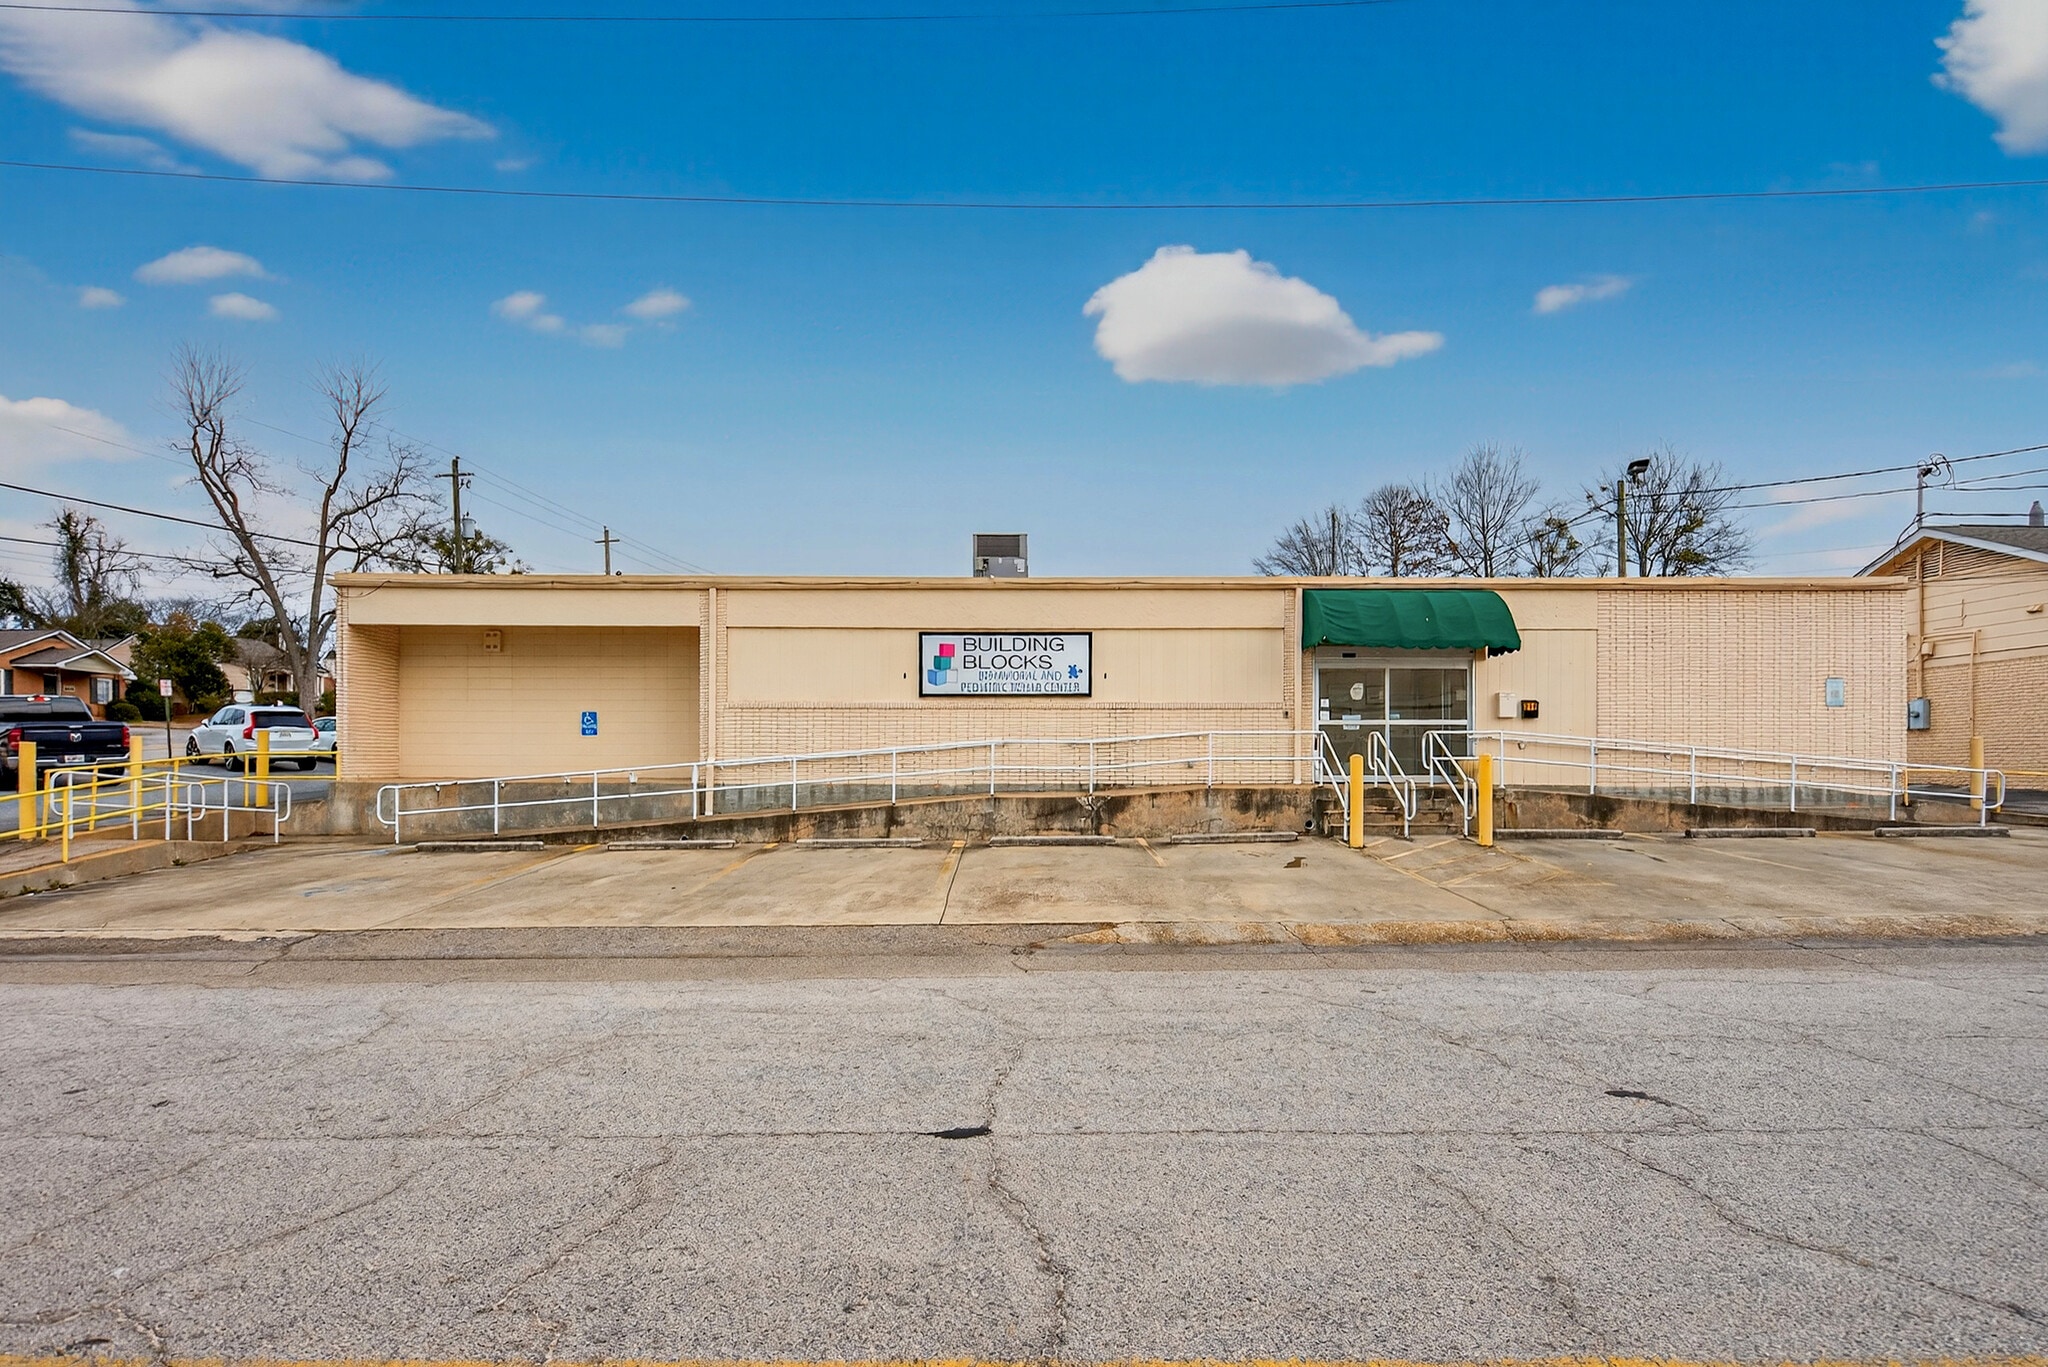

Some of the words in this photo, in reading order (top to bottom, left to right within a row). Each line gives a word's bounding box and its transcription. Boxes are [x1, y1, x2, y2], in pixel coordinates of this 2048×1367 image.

[963, 637, 1065, 652] BUILDING
[963, 654, 1053, 670] BLOCKS
[1041, 670, 1062, 681] AND
